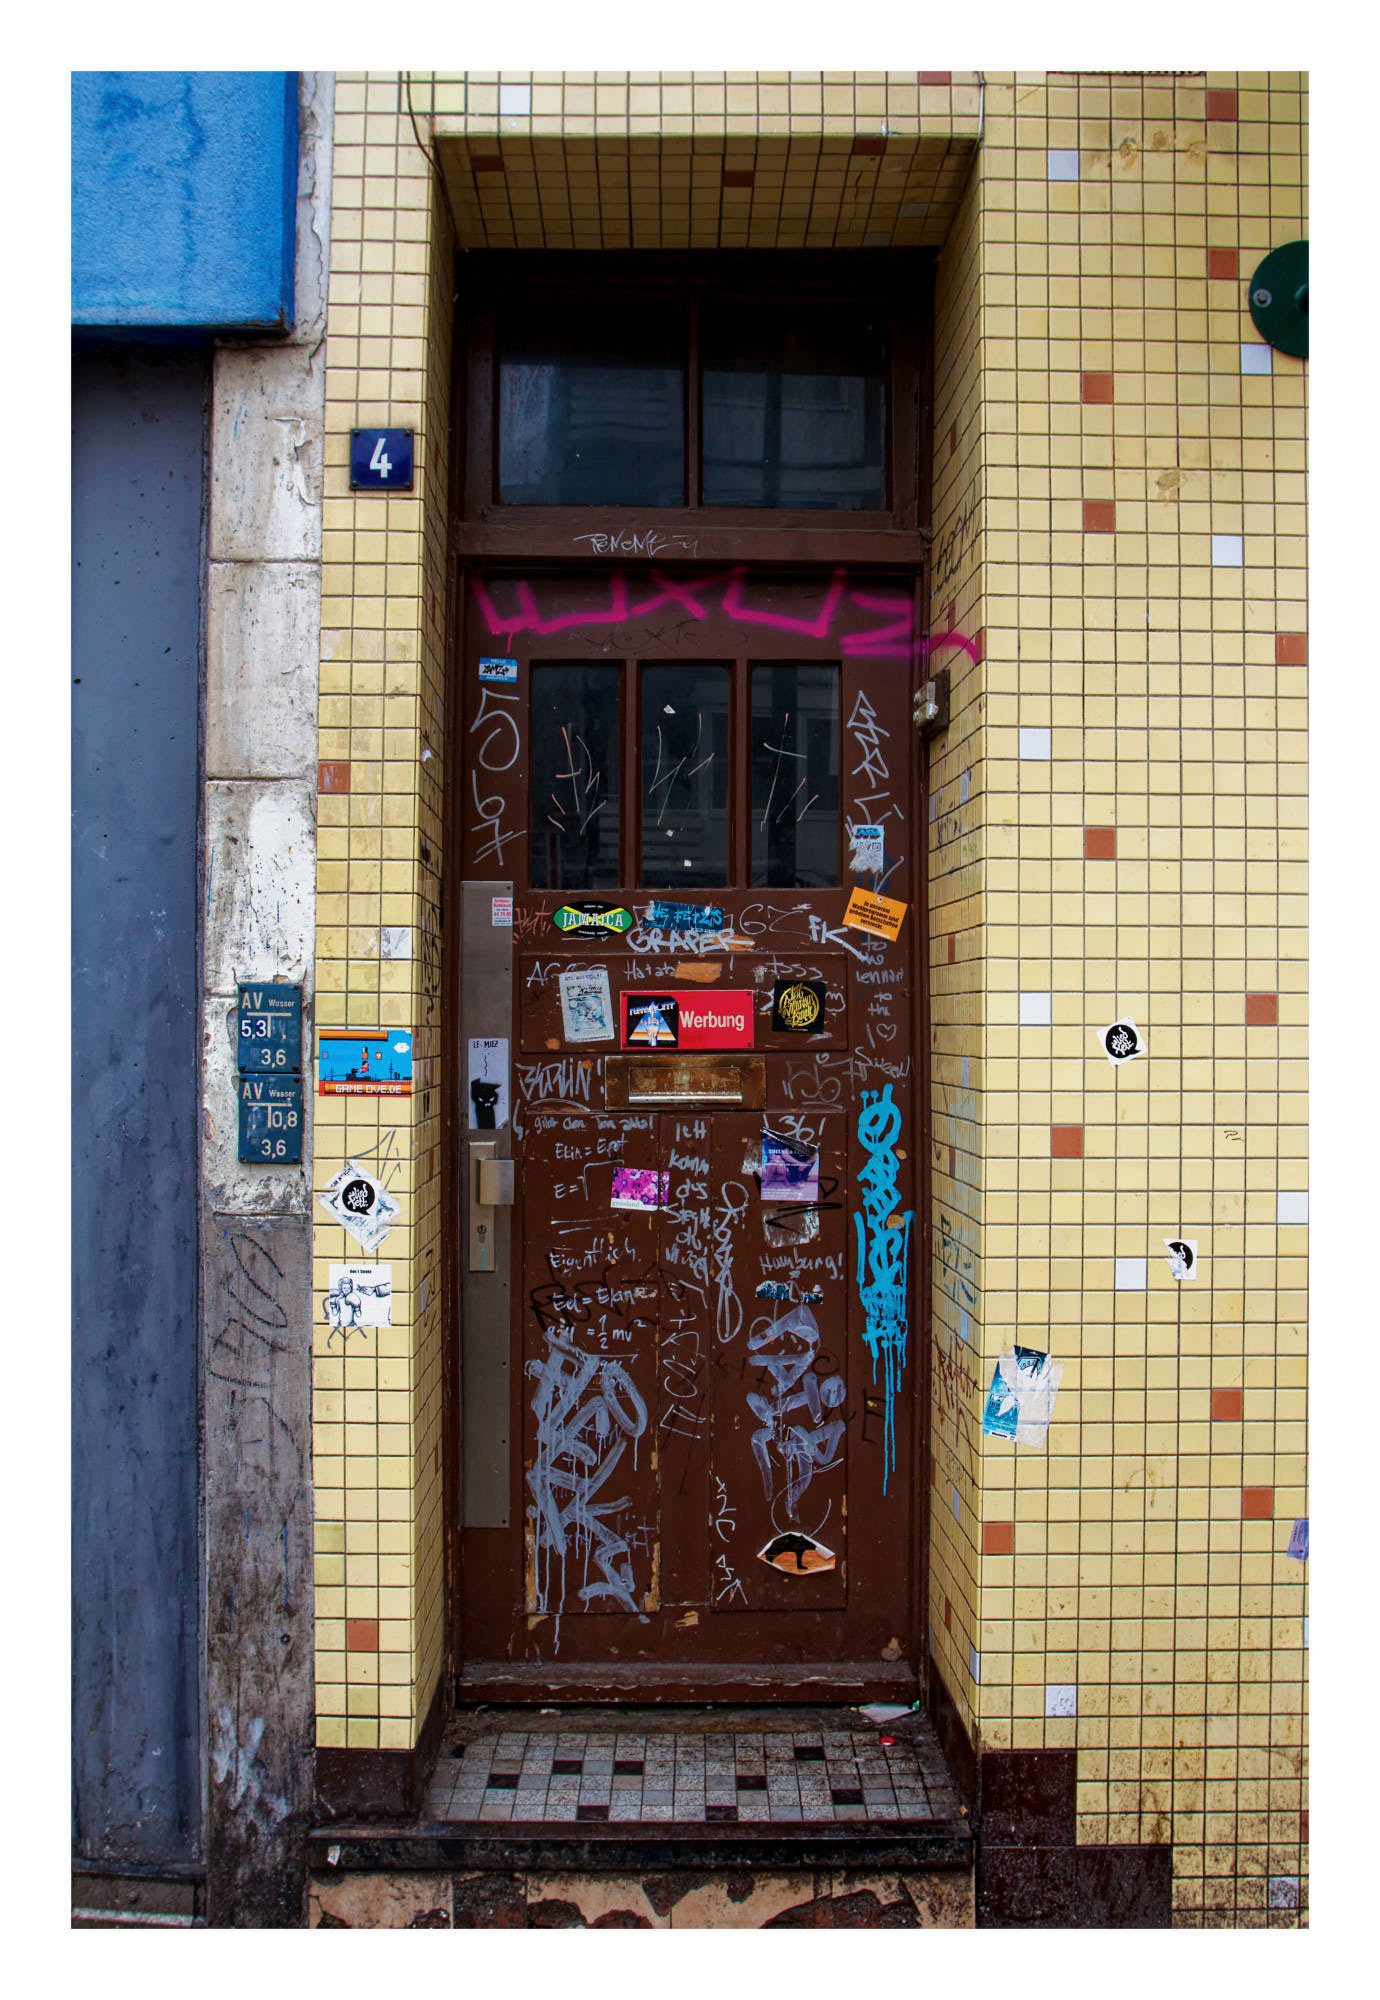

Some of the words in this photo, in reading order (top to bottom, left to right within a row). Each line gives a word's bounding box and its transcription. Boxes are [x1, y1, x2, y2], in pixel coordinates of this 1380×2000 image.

[369, 437, 393, 479] 4
[561, 911, 625, 928] JAMAICA
[241, 992, 264, 1010] AV
[268, 1000, 296, 1008] Wasser
[241, 1020, 267, 1040] 5,3
[679, 1010, 745, 1031] Werbung
[260, 1049, 287, 1068] 3,6
[242, 1082, 264, 1100] AV
[268, 1089, 296, 1098] Wasser
[335, 1084, 363, 1094] GAME
[272, 1111, 298, 1130] 0,8
[260, 1139, 287, 1158] 3,6
